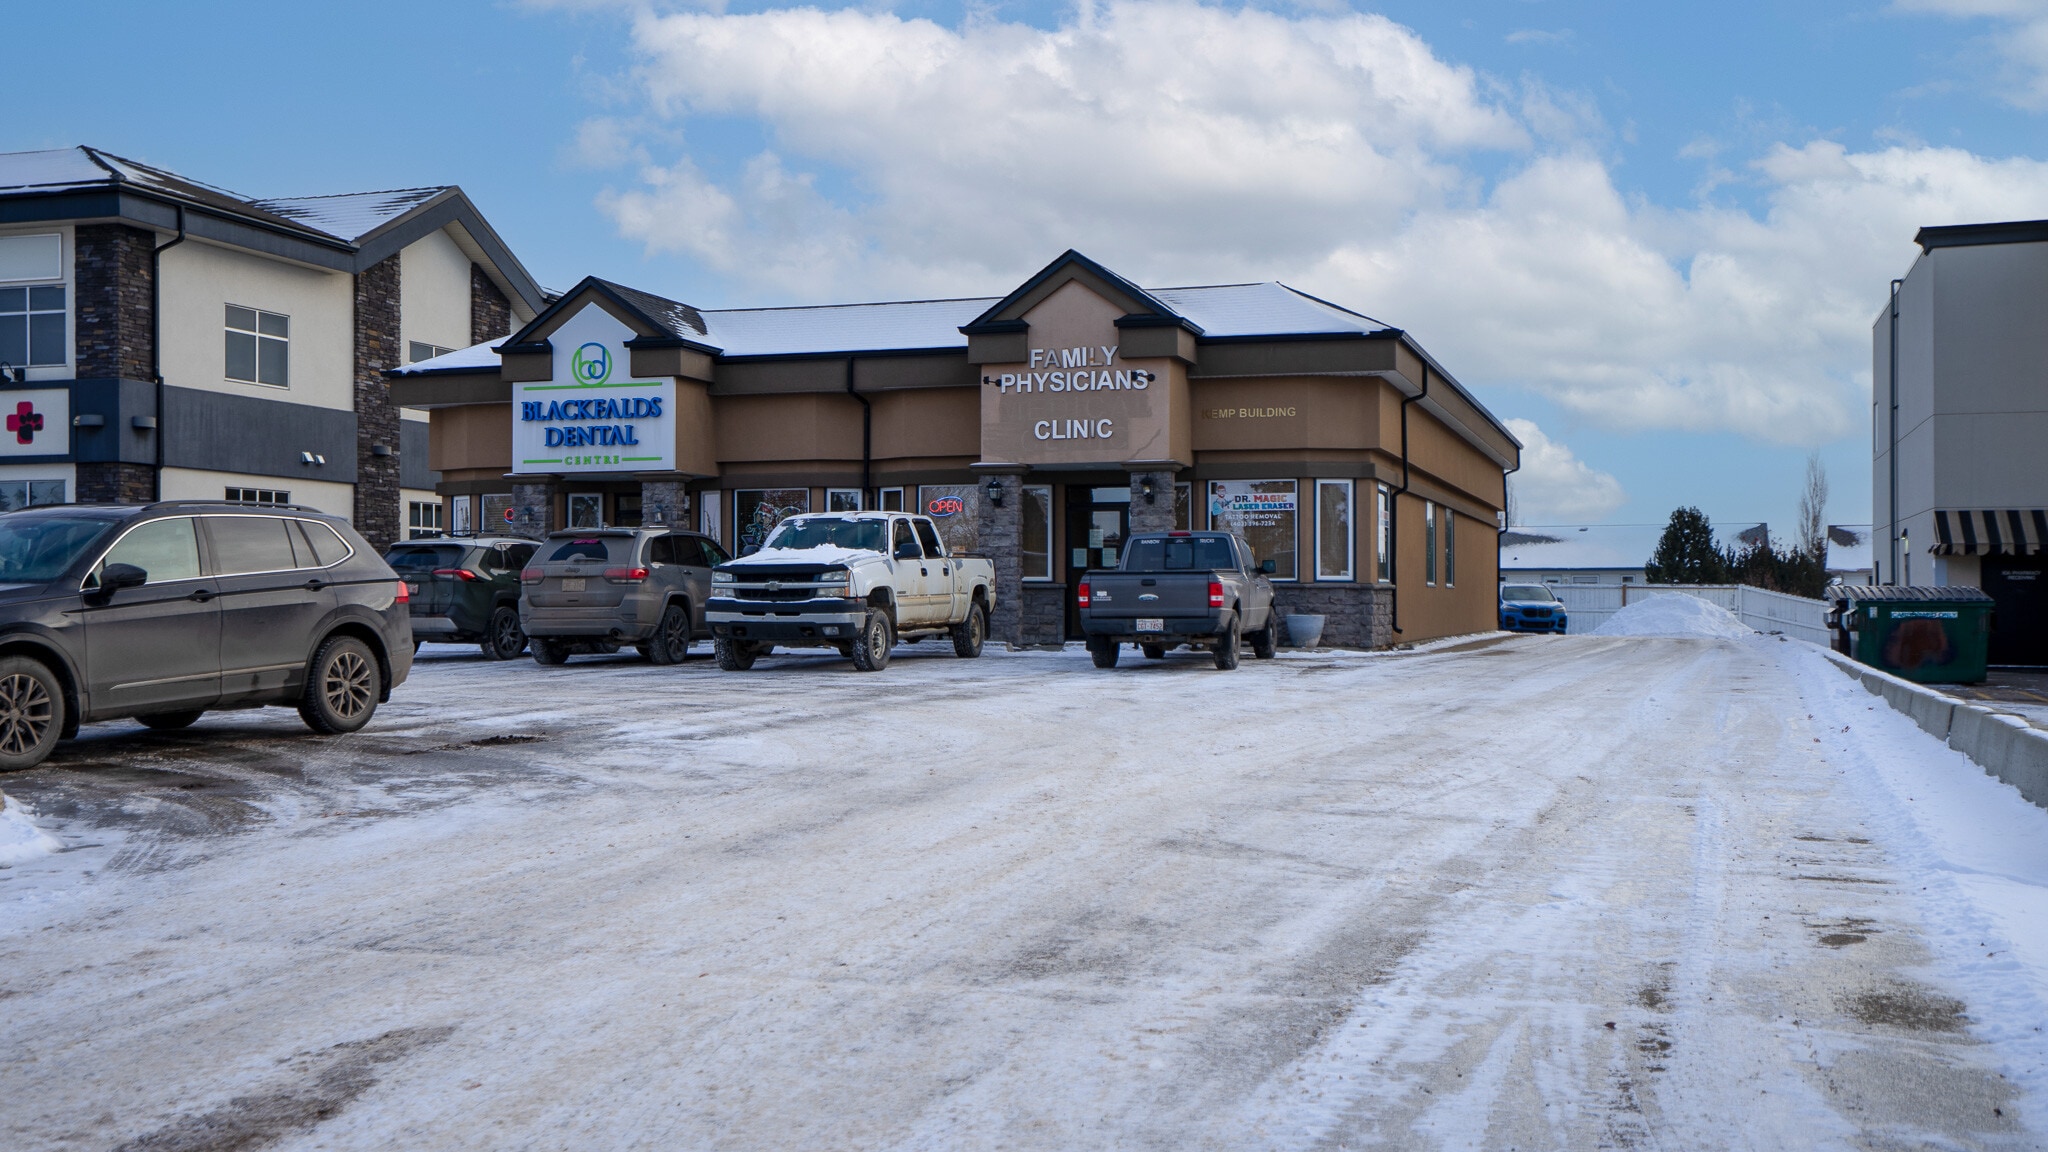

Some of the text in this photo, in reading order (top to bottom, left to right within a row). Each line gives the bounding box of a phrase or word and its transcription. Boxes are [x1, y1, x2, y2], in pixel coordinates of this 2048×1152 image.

[1030, 345, 1119, 369] FAMILY
[1000, 369, 1150, 394] PHYSICIANS
[521, 397, 662, 421] BLACKFALDS
[1239, 406, 1297, 418] BUILDING
[544, 425, 639, 447] DENTAL
[1034, 418, 1114, 440] CLINIC
[564, 455, 620, 466] CENTRE
[929, 500, 963, 512] OPEN
[1234, 494, 1288, 503] DR. MAGIC
